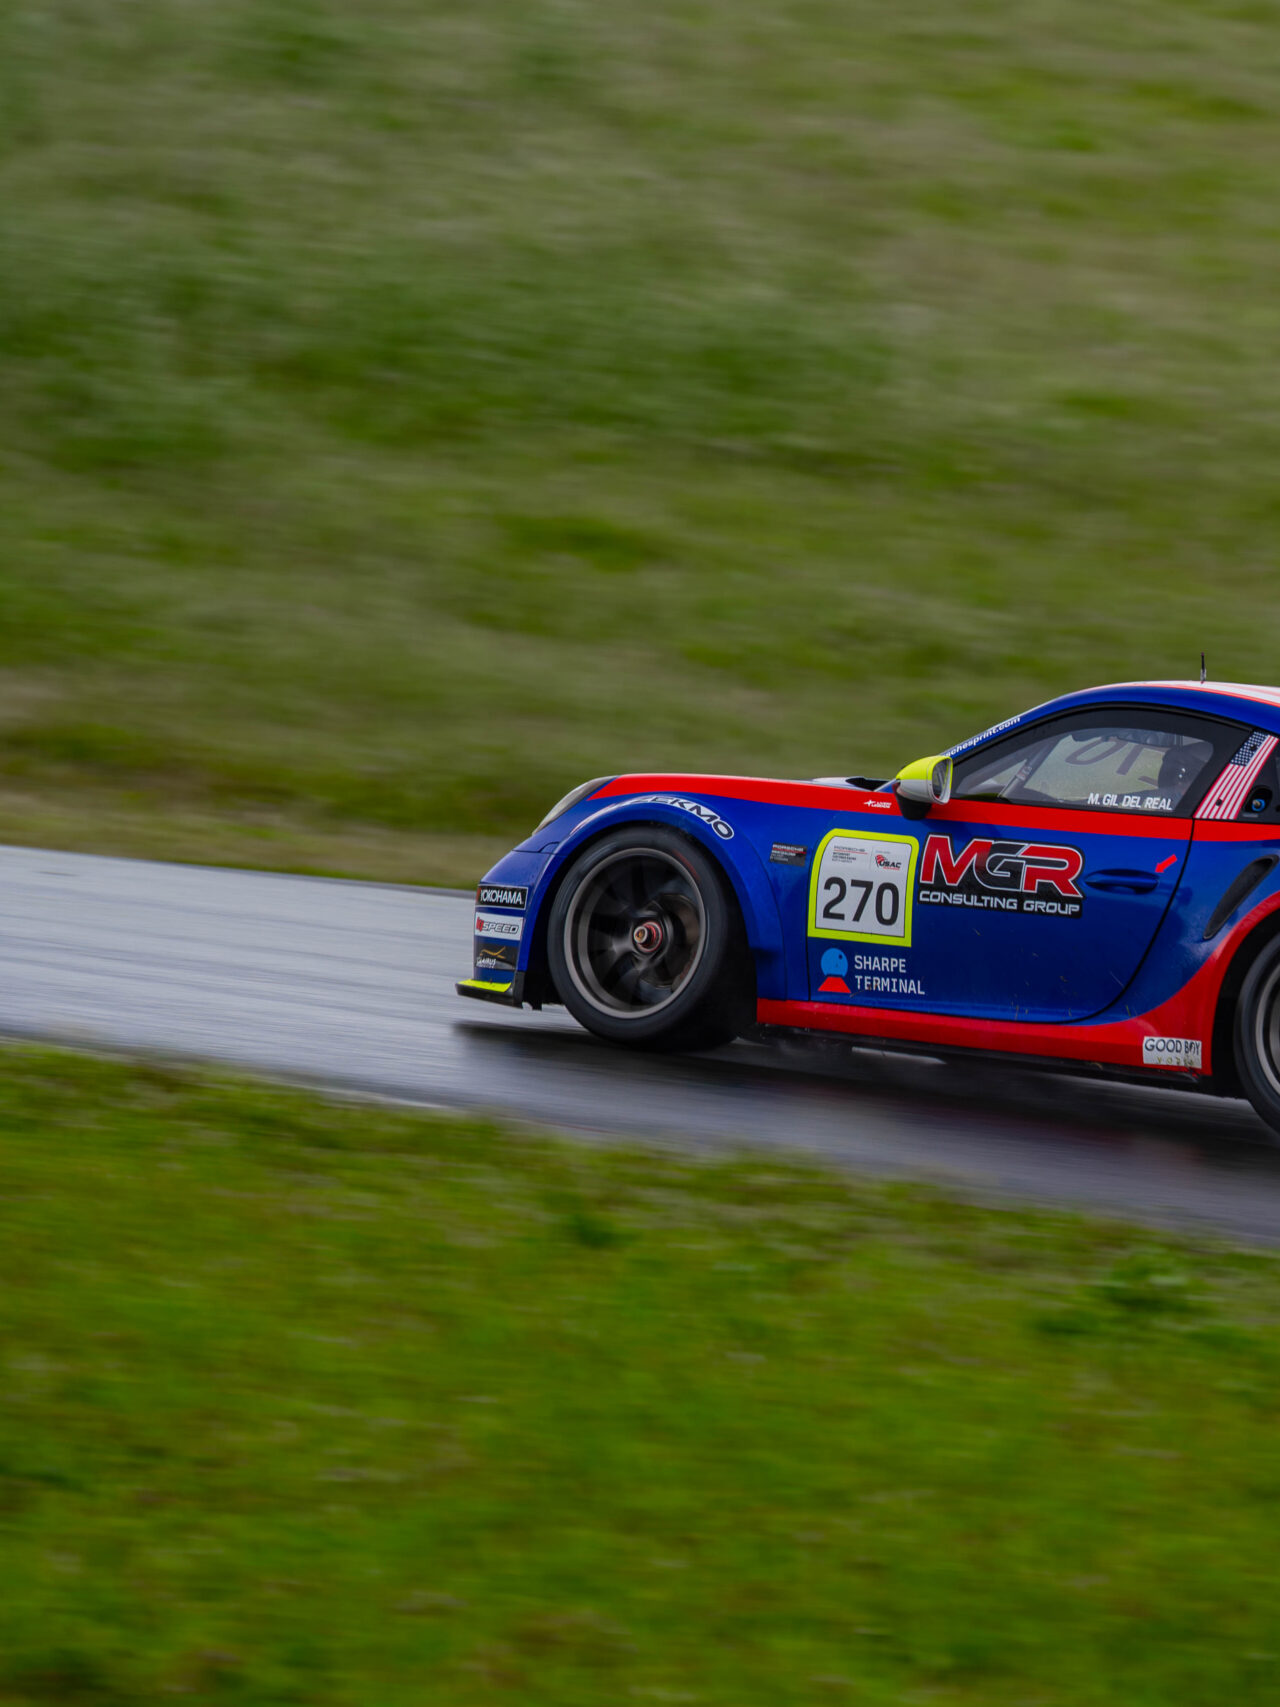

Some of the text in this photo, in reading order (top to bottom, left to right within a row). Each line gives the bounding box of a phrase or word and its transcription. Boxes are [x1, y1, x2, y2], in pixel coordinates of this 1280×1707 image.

[1087, 793, 1173, 811] M. GIL DEL REAL
[879, 860, 902, 868] USAC
[919, 833, 1083, 898] MGR
[480, 889, 522, 905] YOKOHAMA
[822, 876, 900, 926] 270
[919, 890, 1080, 915] CONSULTING GROUP
[854, 954, 906, 973] SHARPE
[854, 974, 926, 995] TERMINAL
[1144, 1038, 1200, 1056] GOOD BOY
